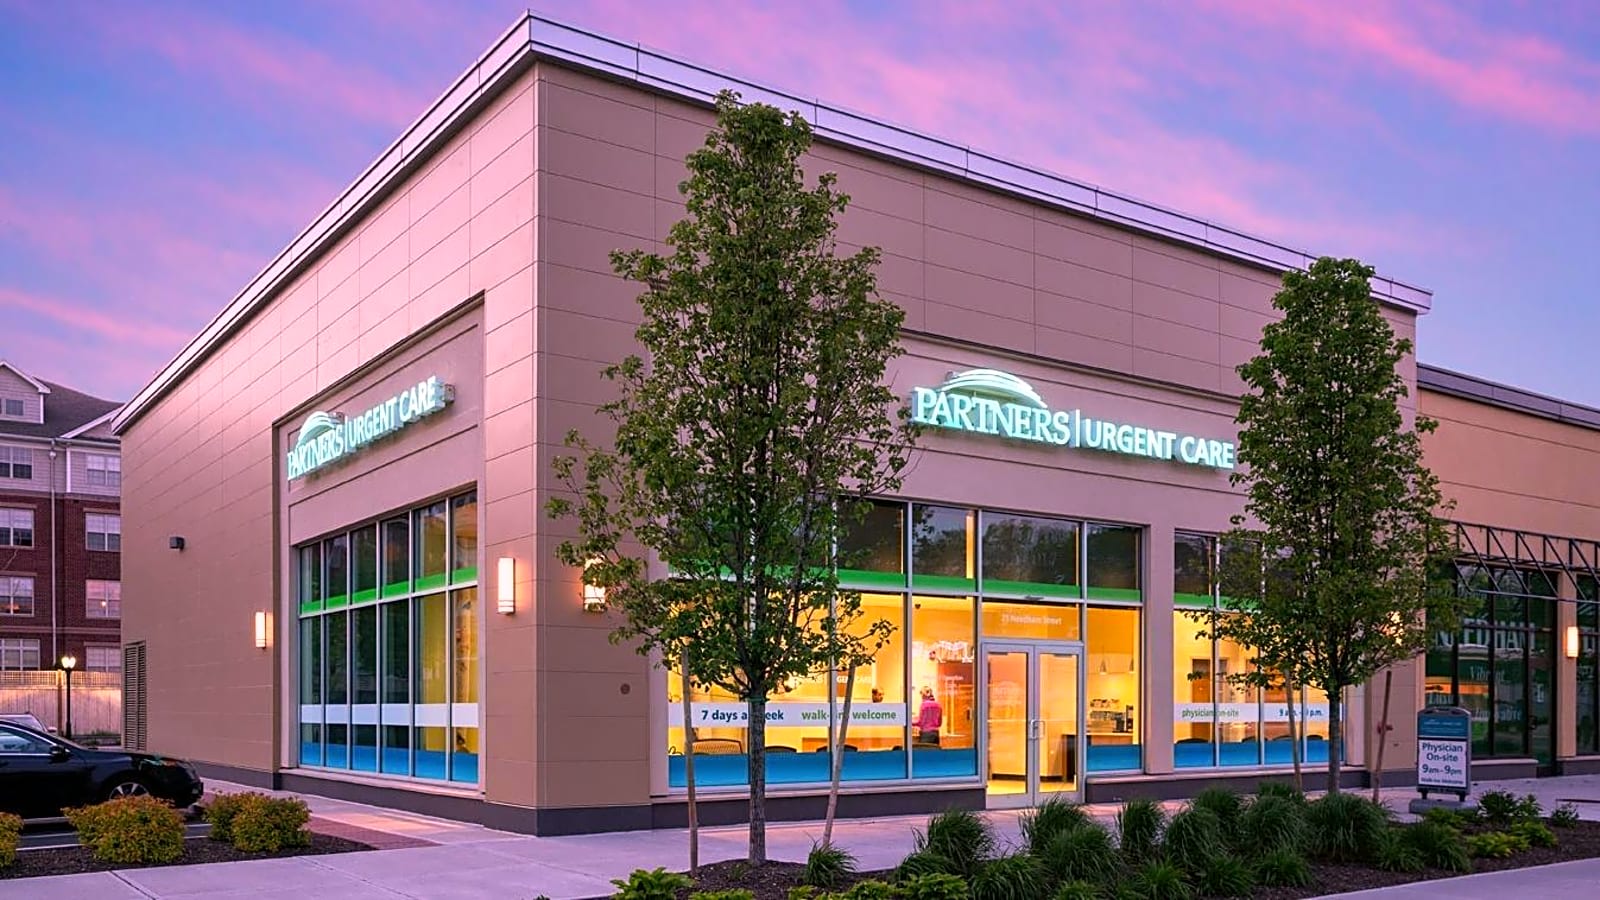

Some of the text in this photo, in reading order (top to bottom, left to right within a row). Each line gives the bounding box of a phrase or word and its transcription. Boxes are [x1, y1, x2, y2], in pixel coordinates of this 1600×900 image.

[287, 376, 437, 481] PARTNERS URGENT CARE
[913, 386, 1234, 469] PARTNERS URGENT CARE
[701, 709, 784, 723] 7 days a eek
[852, 709, 897, 720] welcome
[1182, 708, 1214, 719] physician
[1422, 742, 1463, 753] Physician
[1426, 753, 1459, 762] On-site
